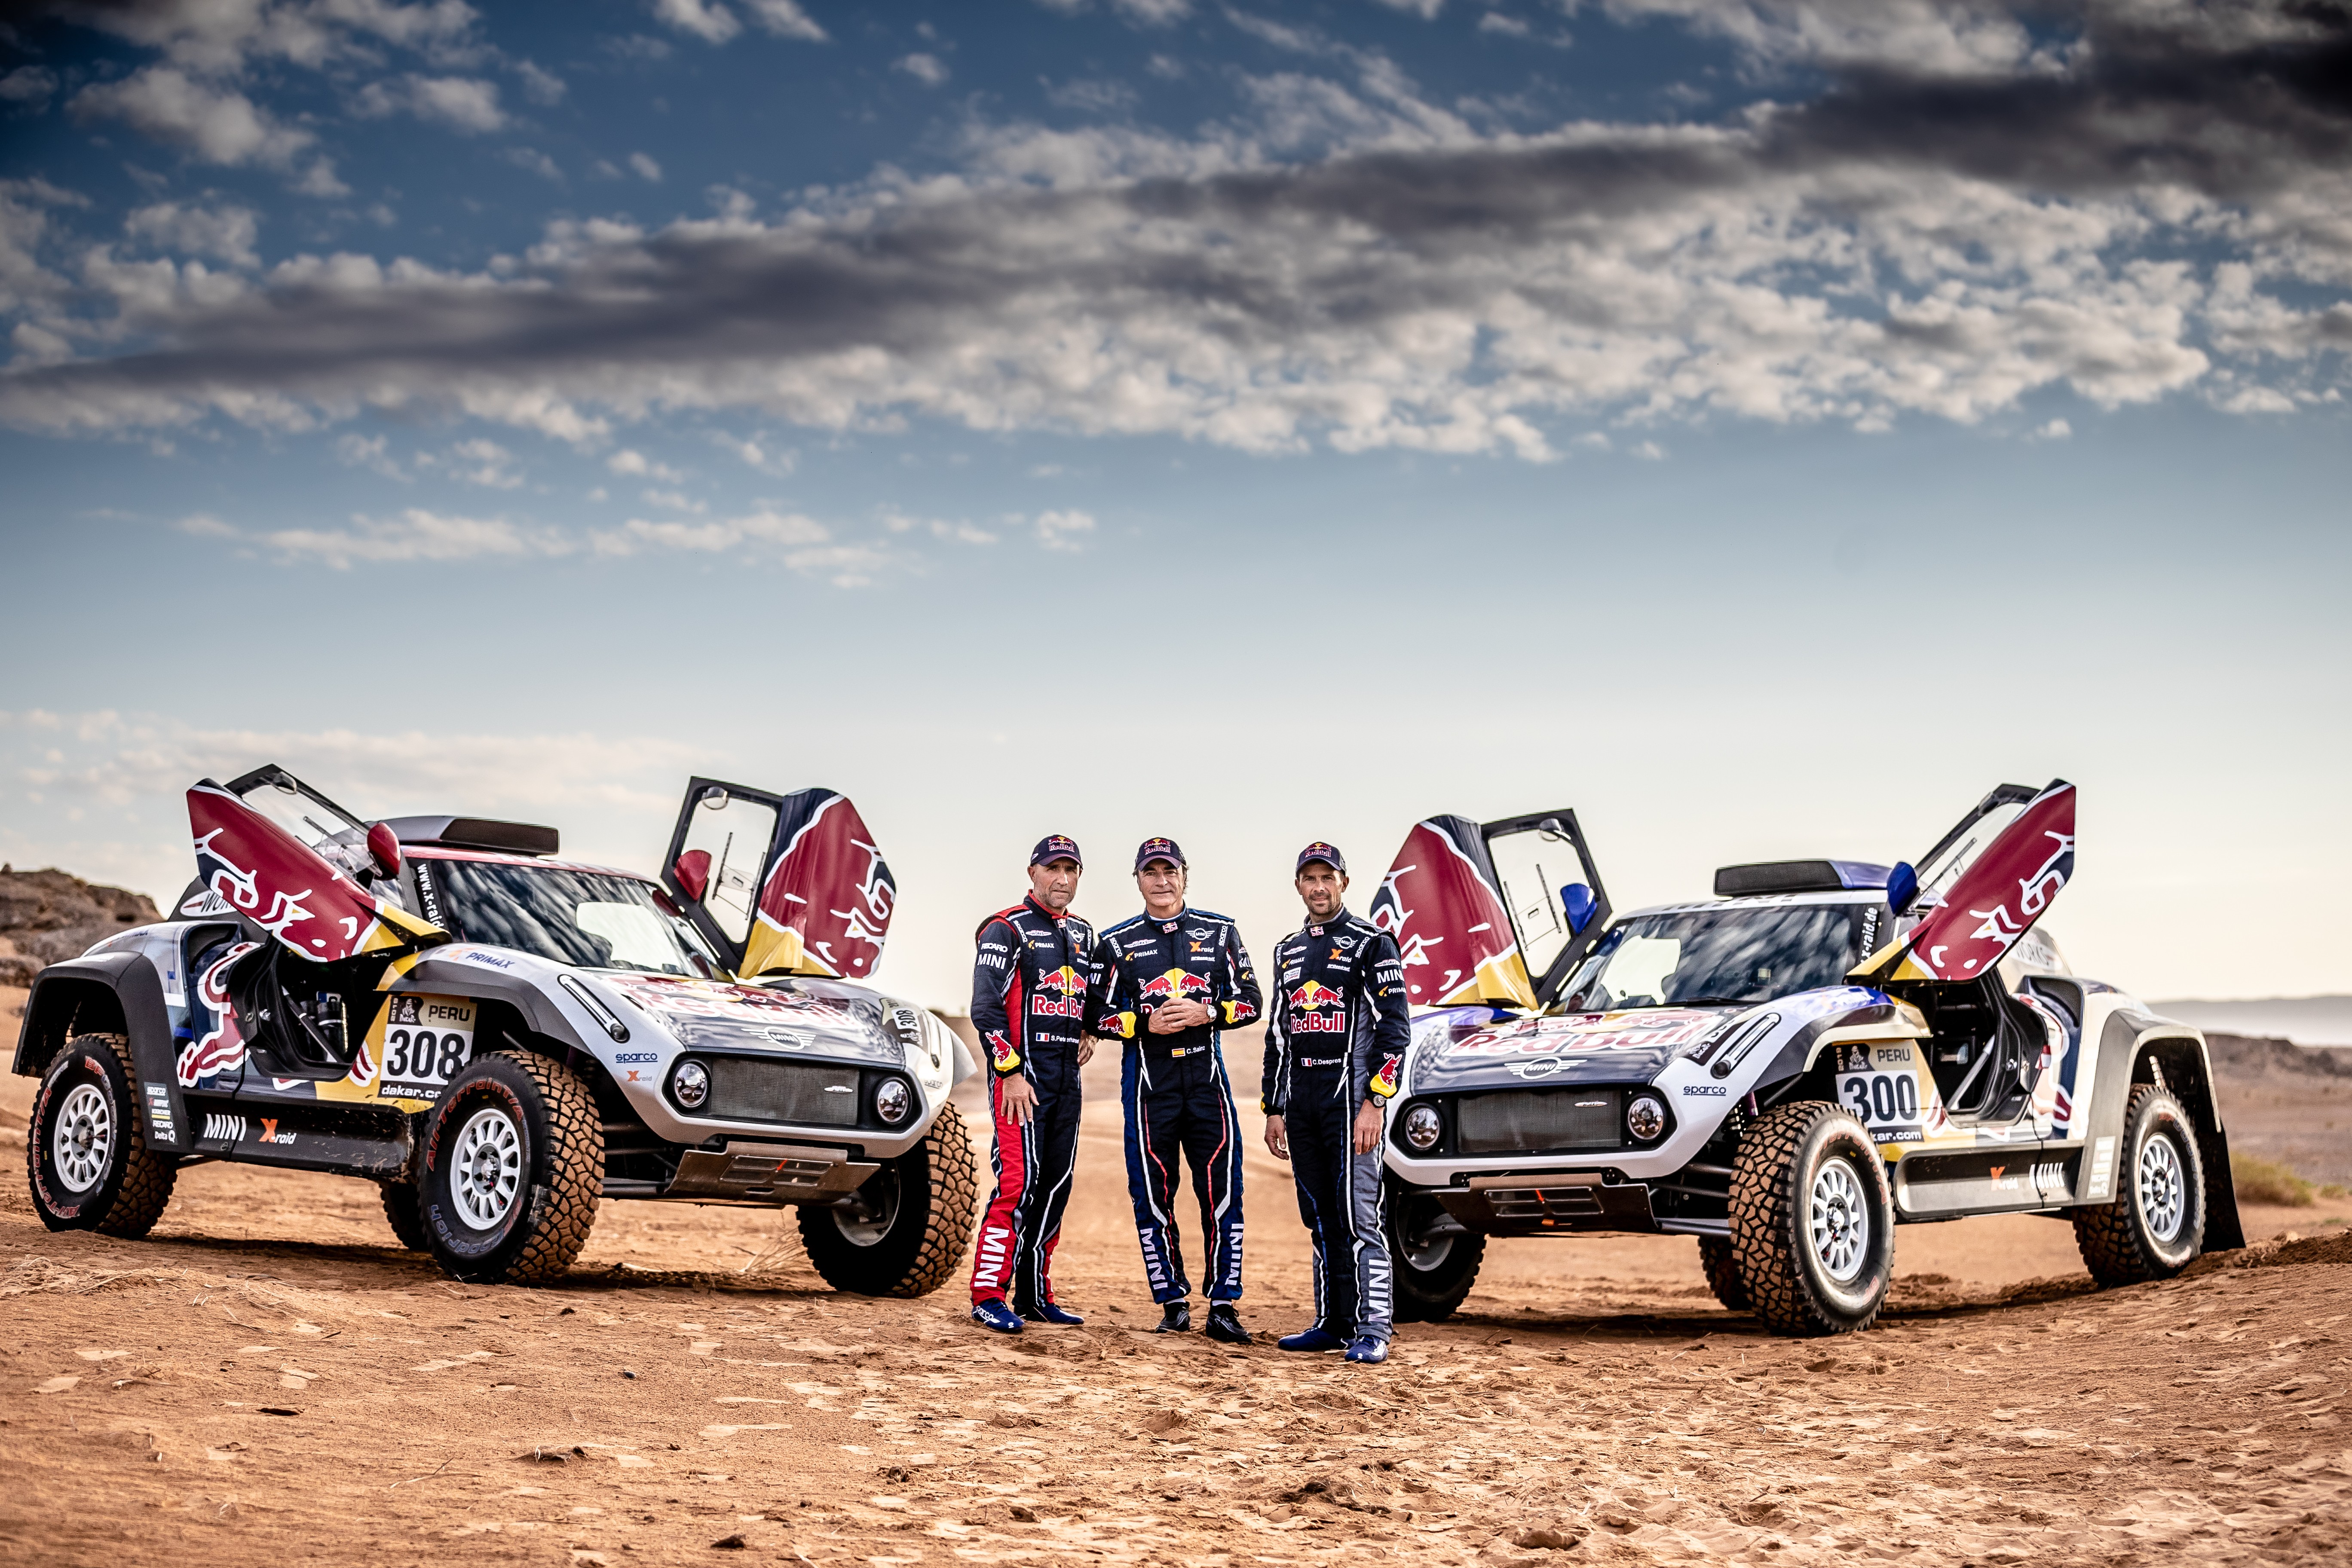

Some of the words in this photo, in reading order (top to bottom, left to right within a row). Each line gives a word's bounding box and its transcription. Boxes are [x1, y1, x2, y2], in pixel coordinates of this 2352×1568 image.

[981, 943, 1008, 952] RECARO
[1109, 937, 1122, 957] sparco
[1134, 949, 1158, 958] PRIMAX
[1355, 937, 1370, 958] sparco
[466, 952, 515, 968] PRIMAX
[977, 954, 1006, 969] MINI
[1377, 969, 1404, 983] MIN
[428, 1005, 470, 1022] PERU
[1032, 994, 1068, 1016] Red
[896, 1010, 917, 1026] 308
[1291, 1011, 1309, 1034] Red
[1309, 1011, 1345, 1032] Bull
[770, 1034, 799, 1042] MINI
[1441, 1032, 1568, 1056] Red
[1545, 1019, 1714, 1050] Bull
[387, 1029, 465, 1080] 308
[616, 1053, 658, 1063] sparco
[1877, 1049, 1911, 1062] PERU
[1683, 1086, 1726, 1096] sparco
[1844, 1075, 1917, 1123] 300
[203, 1113, 246, 1141] MINI
[974, 1227, 1009, 1288] MINI
[1140, 1228, 1168, 1289] MINI
[1225, 1223, 1244, 1286] MINI
[1369, 1259, 1389, 1323] MINI
